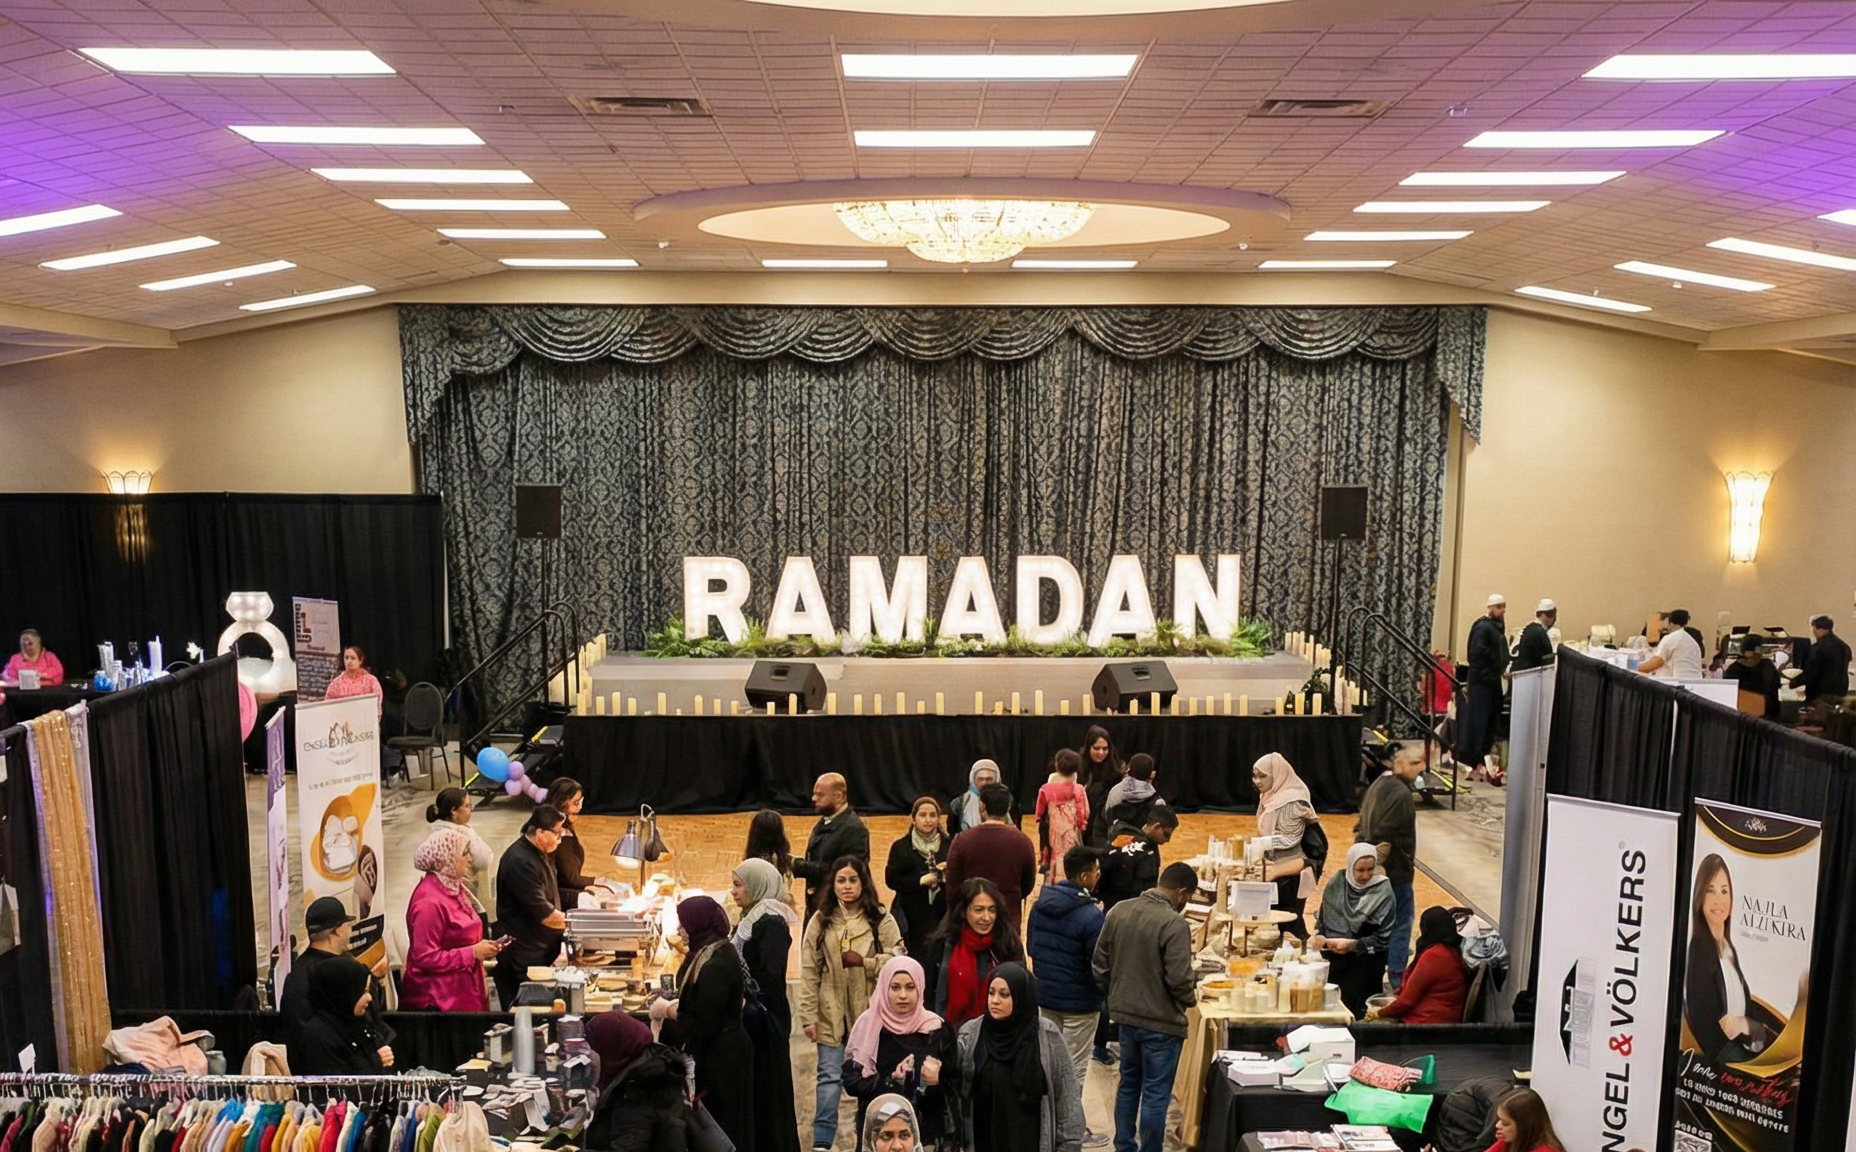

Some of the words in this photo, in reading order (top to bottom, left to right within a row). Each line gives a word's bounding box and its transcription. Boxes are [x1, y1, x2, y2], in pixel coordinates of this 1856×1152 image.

[683, 553, 1241, 646] RAMADAN
[1606, 849, 1647, 1028] VÖLKERS
[1609, 1033, 1633, 1057] &
